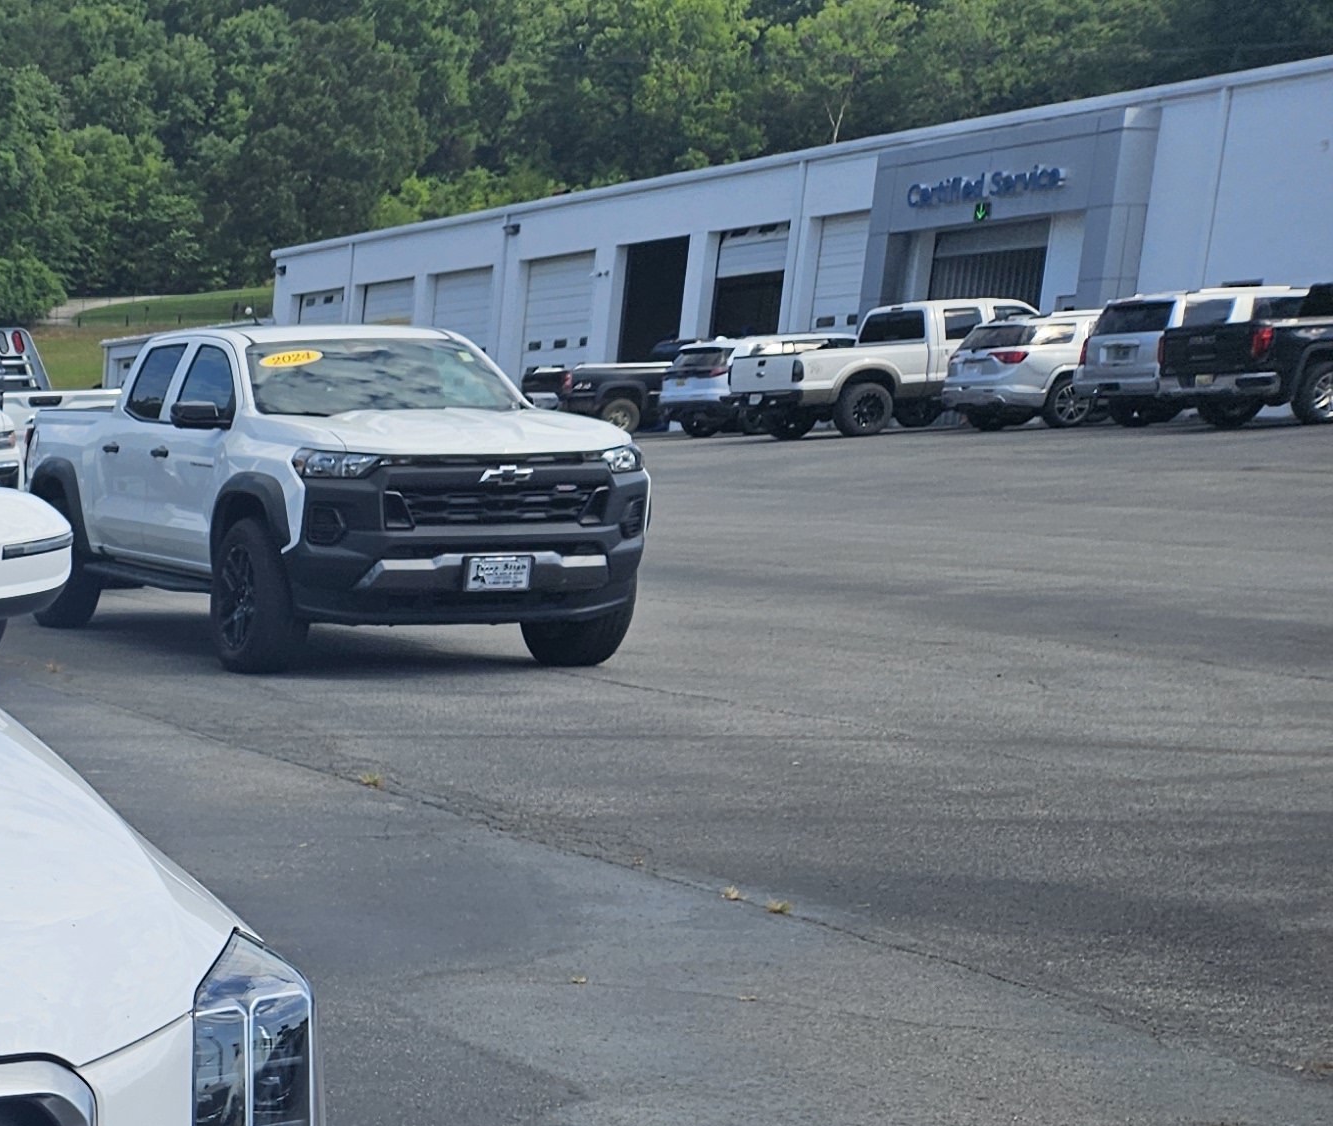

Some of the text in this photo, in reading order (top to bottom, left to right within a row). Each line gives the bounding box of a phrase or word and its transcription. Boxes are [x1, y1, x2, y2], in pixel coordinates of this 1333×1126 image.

[907, 165, 1066, 207] Certified Service
[272, 352, 311, 365] 2024
